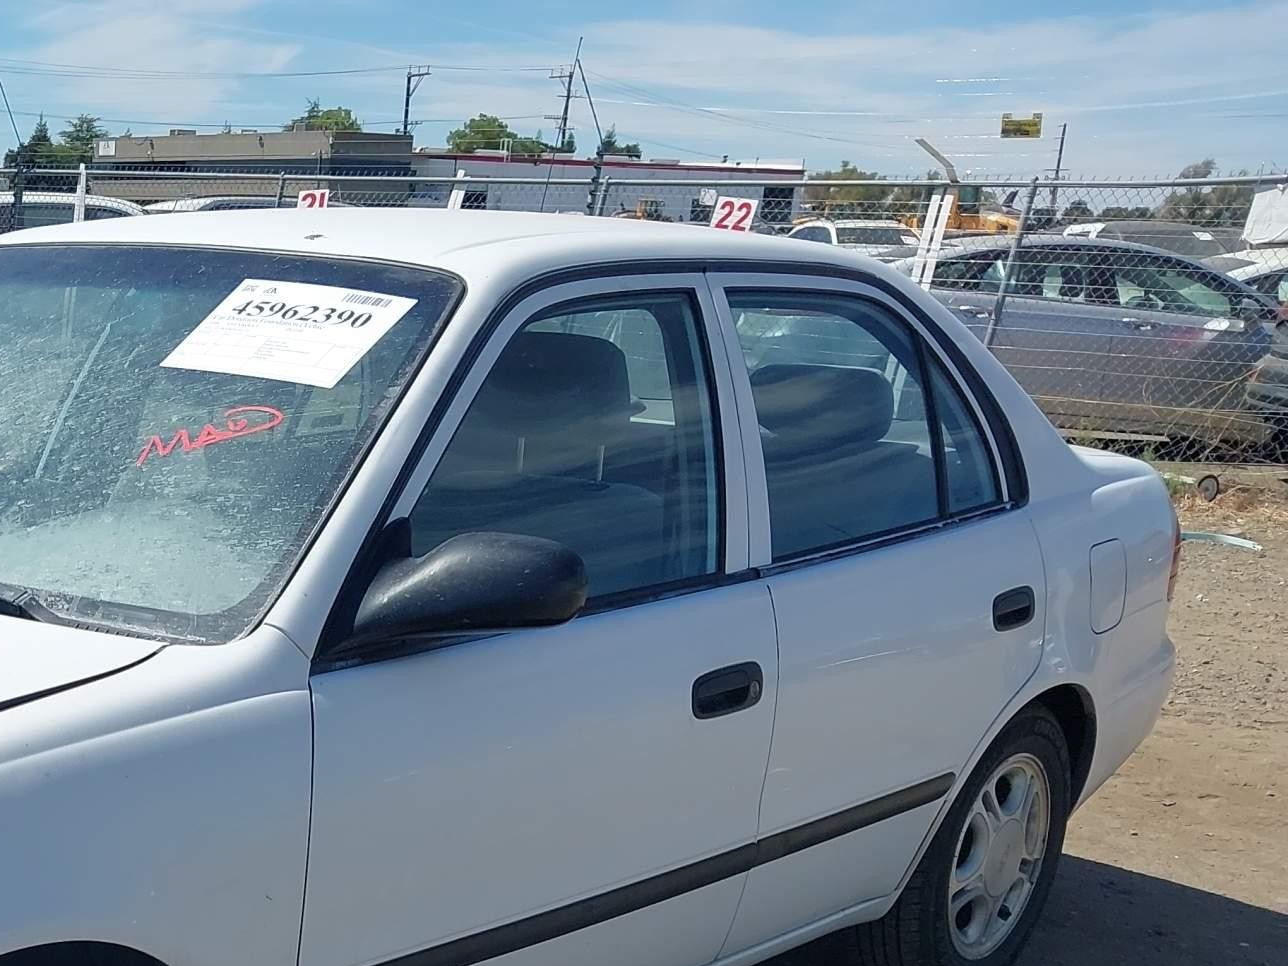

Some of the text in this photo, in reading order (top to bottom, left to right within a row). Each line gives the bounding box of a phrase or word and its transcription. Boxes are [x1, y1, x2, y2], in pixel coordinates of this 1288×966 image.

[300, 192, 327, 208] 21
[714, 200, 753, 231] 22
[231, 298, 373, 329] 45962390
